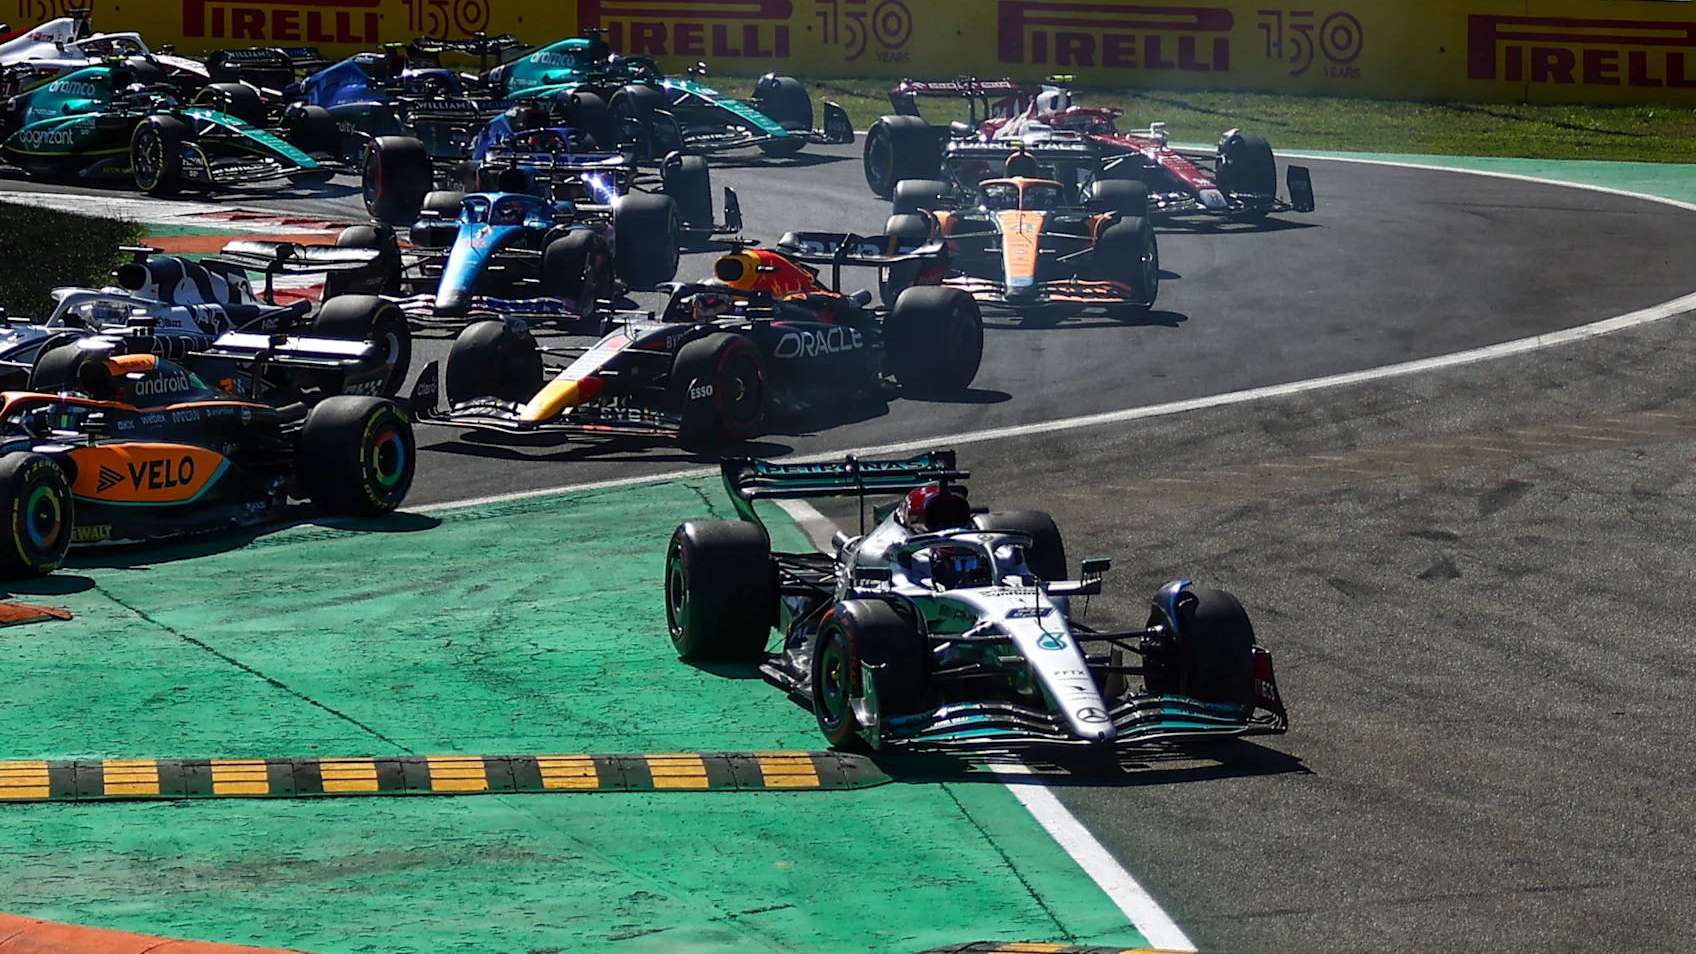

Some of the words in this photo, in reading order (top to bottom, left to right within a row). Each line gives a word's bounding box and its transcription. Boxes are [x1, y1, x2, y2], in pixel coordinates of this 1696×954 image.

[998, 1, 1234, 72] PIRELLI
[1258, 10, 1364, 76] 150
[226, 50, 274, 60] WILLIAMS
[530, 52, 577, 68] aramco
[876, 51, 910, 63] YEARS
[1467, 15, 1696, 89] PIRELL
[1324, 67, 1360, 79] YEARS
[48, 80, 97, 97] aramco
[18, 128, 74, 149] cognizant
[773, 327, 864, 359] ORACLE
[135, 372, 190, 397] android
[416, 382, 439, 397] Claro
[690, 383, 714, 400] ESSO
[140, 411, 167, 425] webex
[32, 459, 60, 475] ZERO
[127, 455, 196, 492] VELO
[763, 458, 927, 475] PETRONAS
